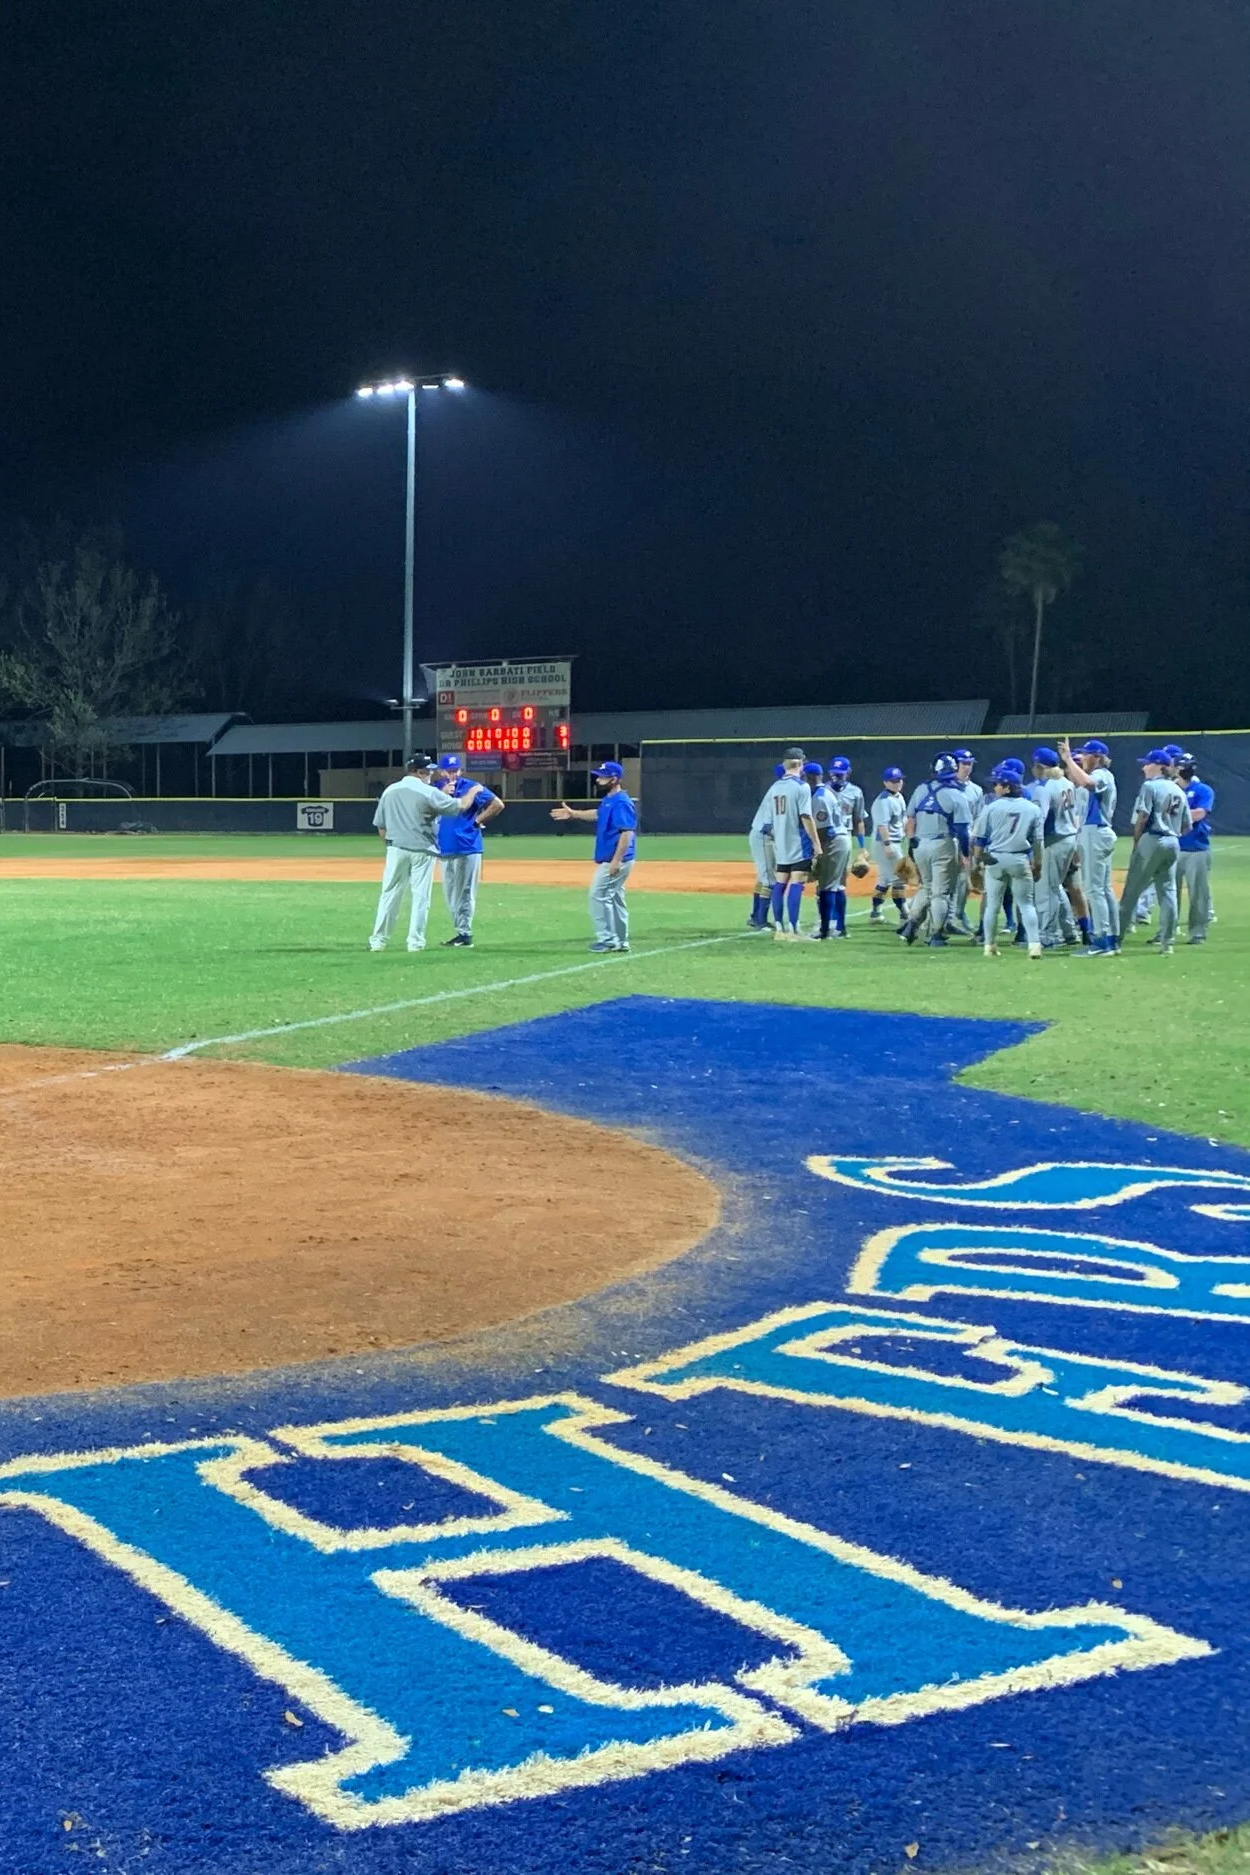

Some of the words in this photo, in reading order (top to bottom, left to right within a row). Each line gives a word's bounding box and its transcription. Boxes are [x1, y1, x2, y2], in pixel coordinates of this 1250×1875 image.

[450, 668, 476, 678] JOHN
[527, 664, 556, 675] FIELD
[454, 677, 499, 687] PHILLIPS
[501, 676, 525, 685] HIGH
[527, 674, 567, 684] SCHOOL
[458, 709, 468, 723] 0
[491, 708, 500, 721] 0
[523, 707, 534, 720] 0
[773, 794, 787, 816] 10
[308, 811, 323, 825] 19
[1008, 812, 1021, 834] 7
